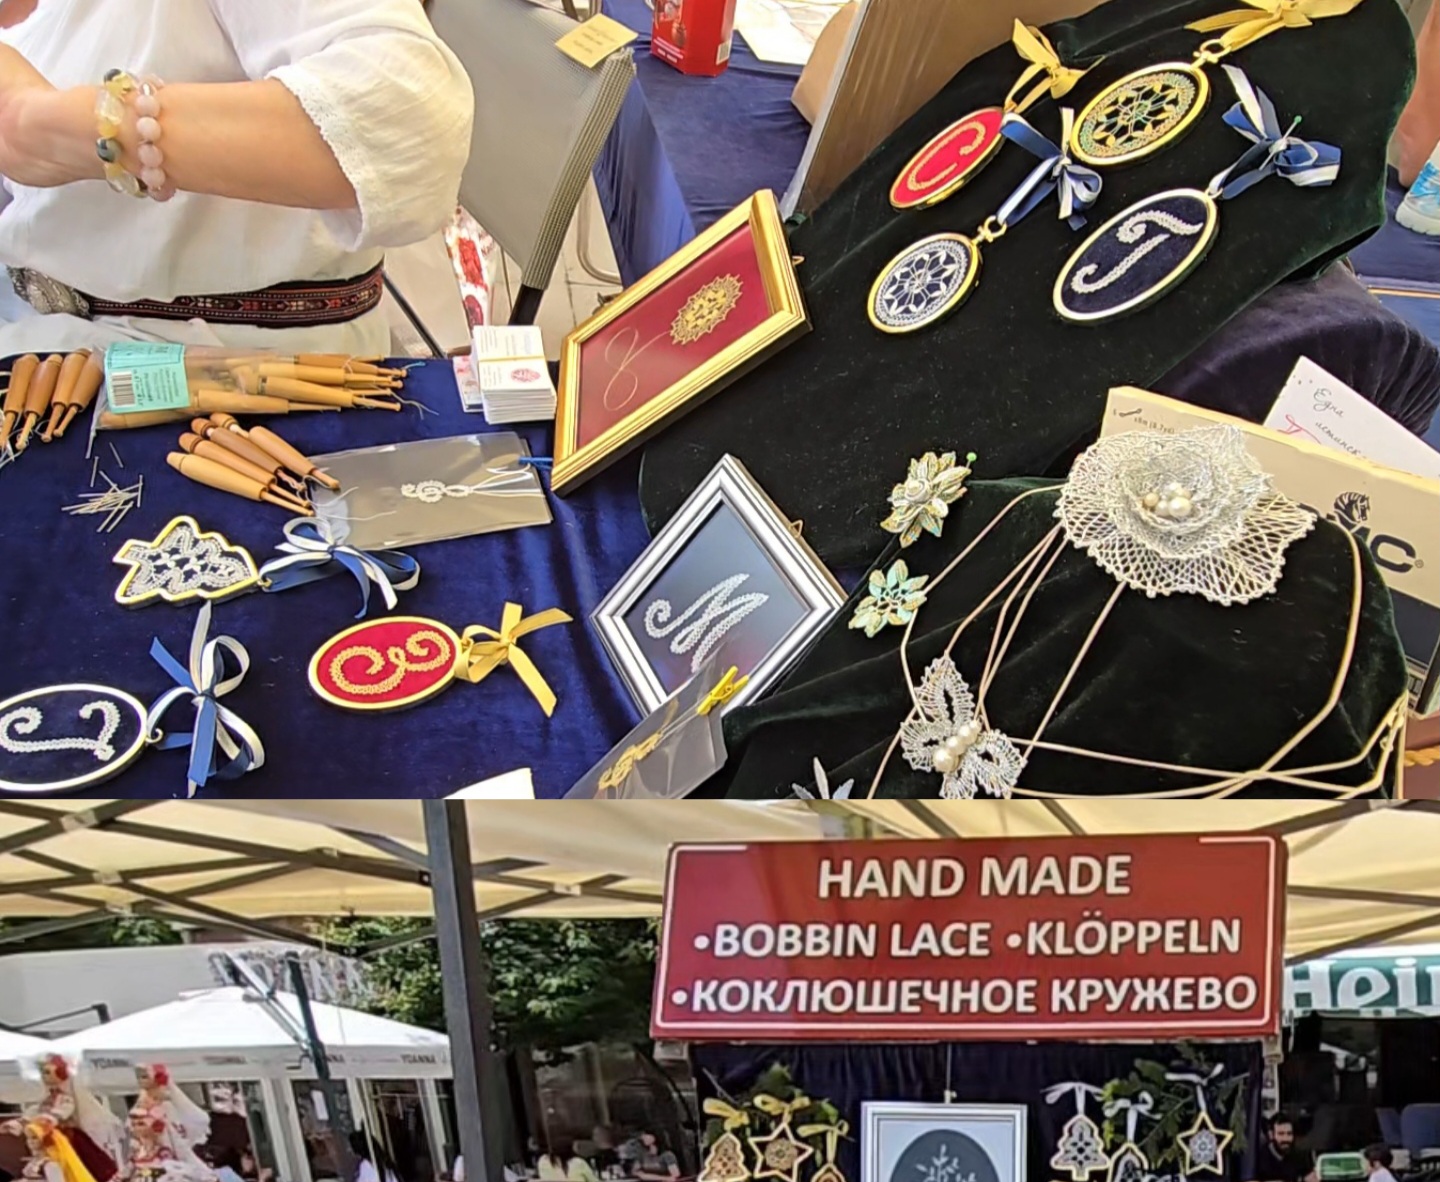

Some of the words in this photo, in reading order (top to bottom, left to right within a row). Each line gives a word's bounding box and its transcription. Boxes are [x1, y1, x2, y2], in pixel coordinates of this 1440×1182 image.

[818, 858, 966, 899] HAND
[980, 854, 1132, 896] MADE
[890, 921, 992, 957] LACE
[1050, 976, 1258, 1014] КРУЖЕВО
